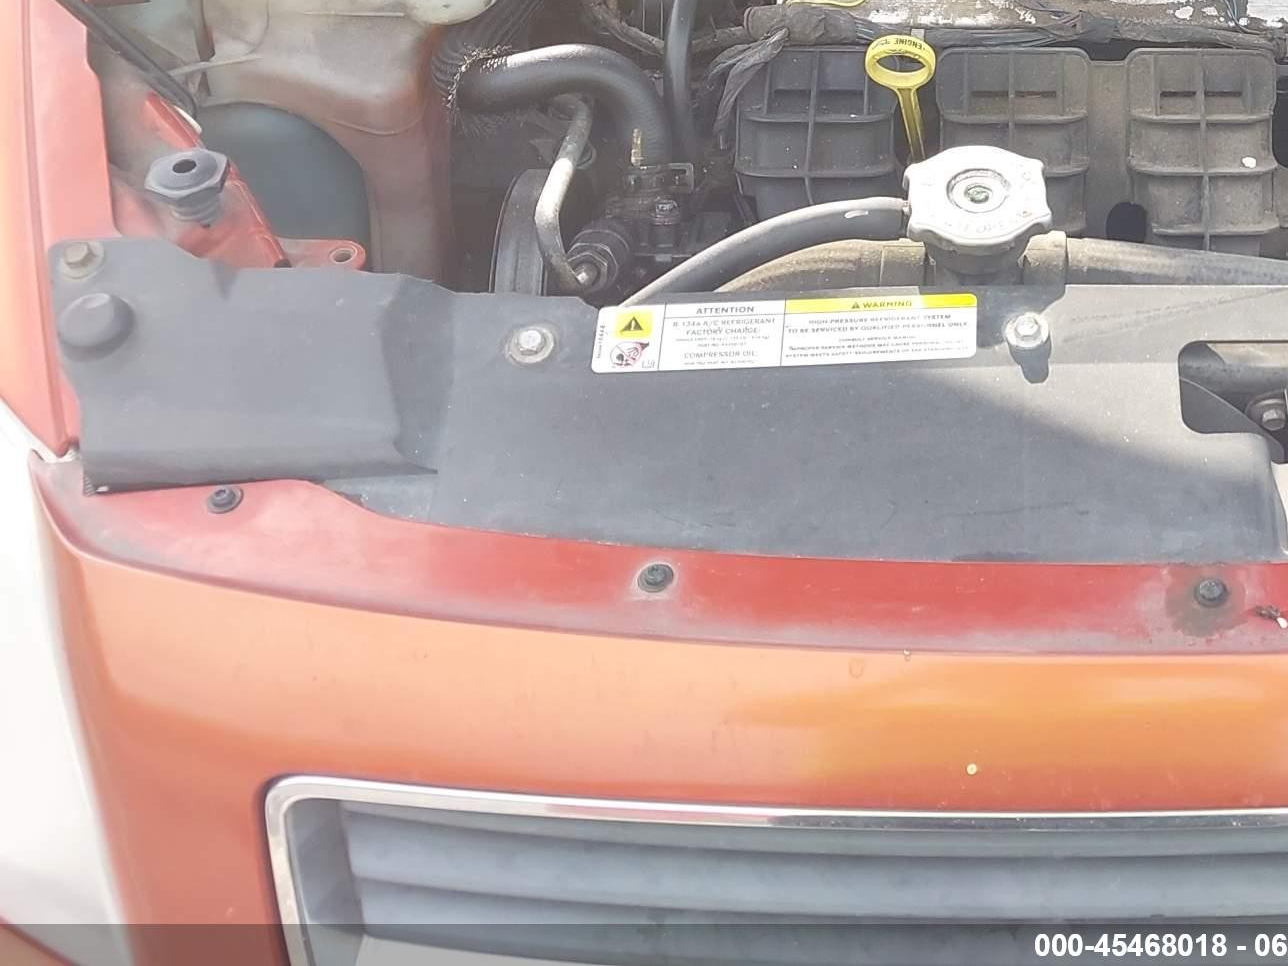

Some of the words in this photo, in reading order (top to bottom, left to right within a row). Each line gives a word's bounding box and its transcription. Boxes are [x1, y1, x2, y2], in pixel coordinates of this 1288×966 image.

[894, 38, 923, 50] ENGINE
[863, 299, 912, 309] WARNING
[696, 306, 755, 315] ATTENTION
[721, 317, 776, 326] REFRIGERANT
[686, 327, 723, 336] FACTORY
[684, 350, 741, 359] COMPRESSOR
